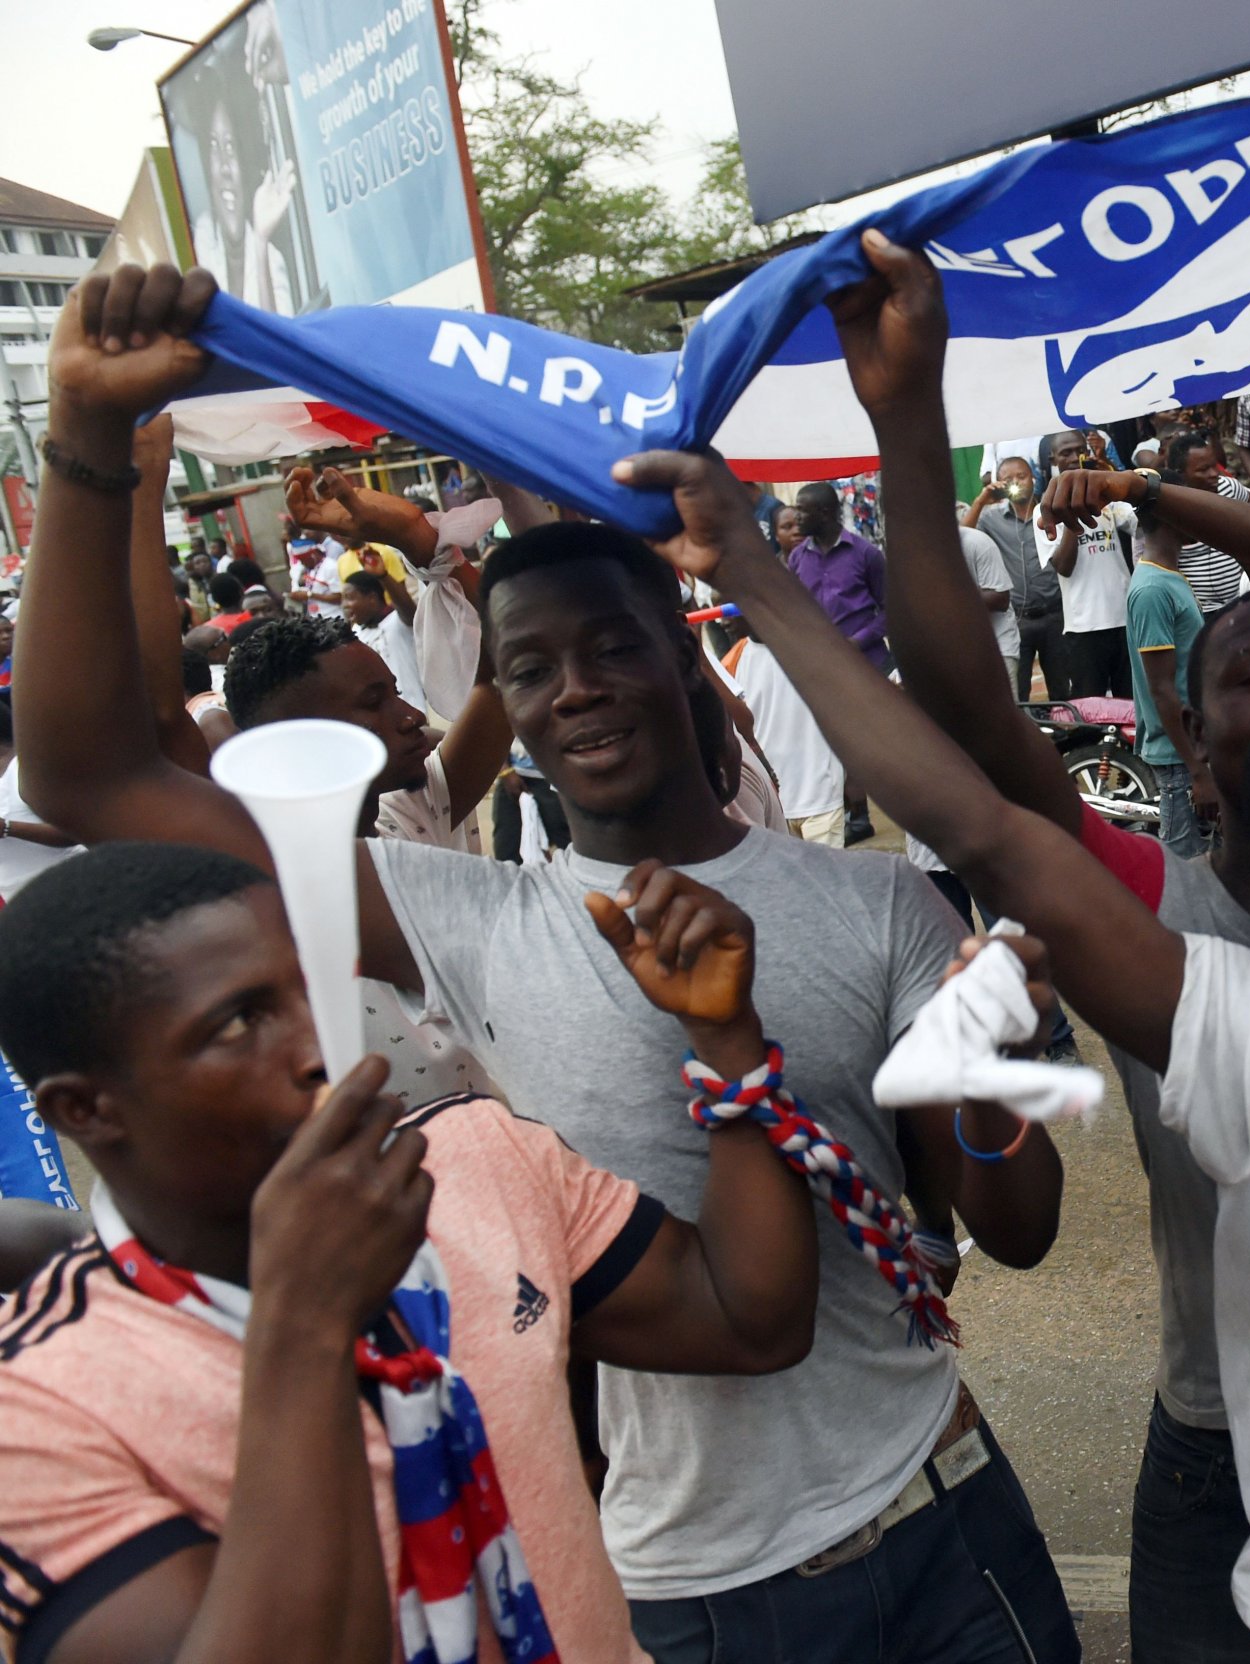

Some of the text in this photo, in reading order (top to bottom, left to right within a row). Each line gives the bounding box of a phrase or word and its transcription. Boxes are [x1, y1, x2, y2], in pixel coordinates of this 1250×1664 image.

[298, 71, 318, 100] We
[315, 48, 345, 89] hold
[343, 40, 366, 72] the
[362, 20, 388, 57] key
[386, 8, 403, 36] to
[318, 44, 420, 146] growth of your
[317, 85, 447, 215] BUSINESS
